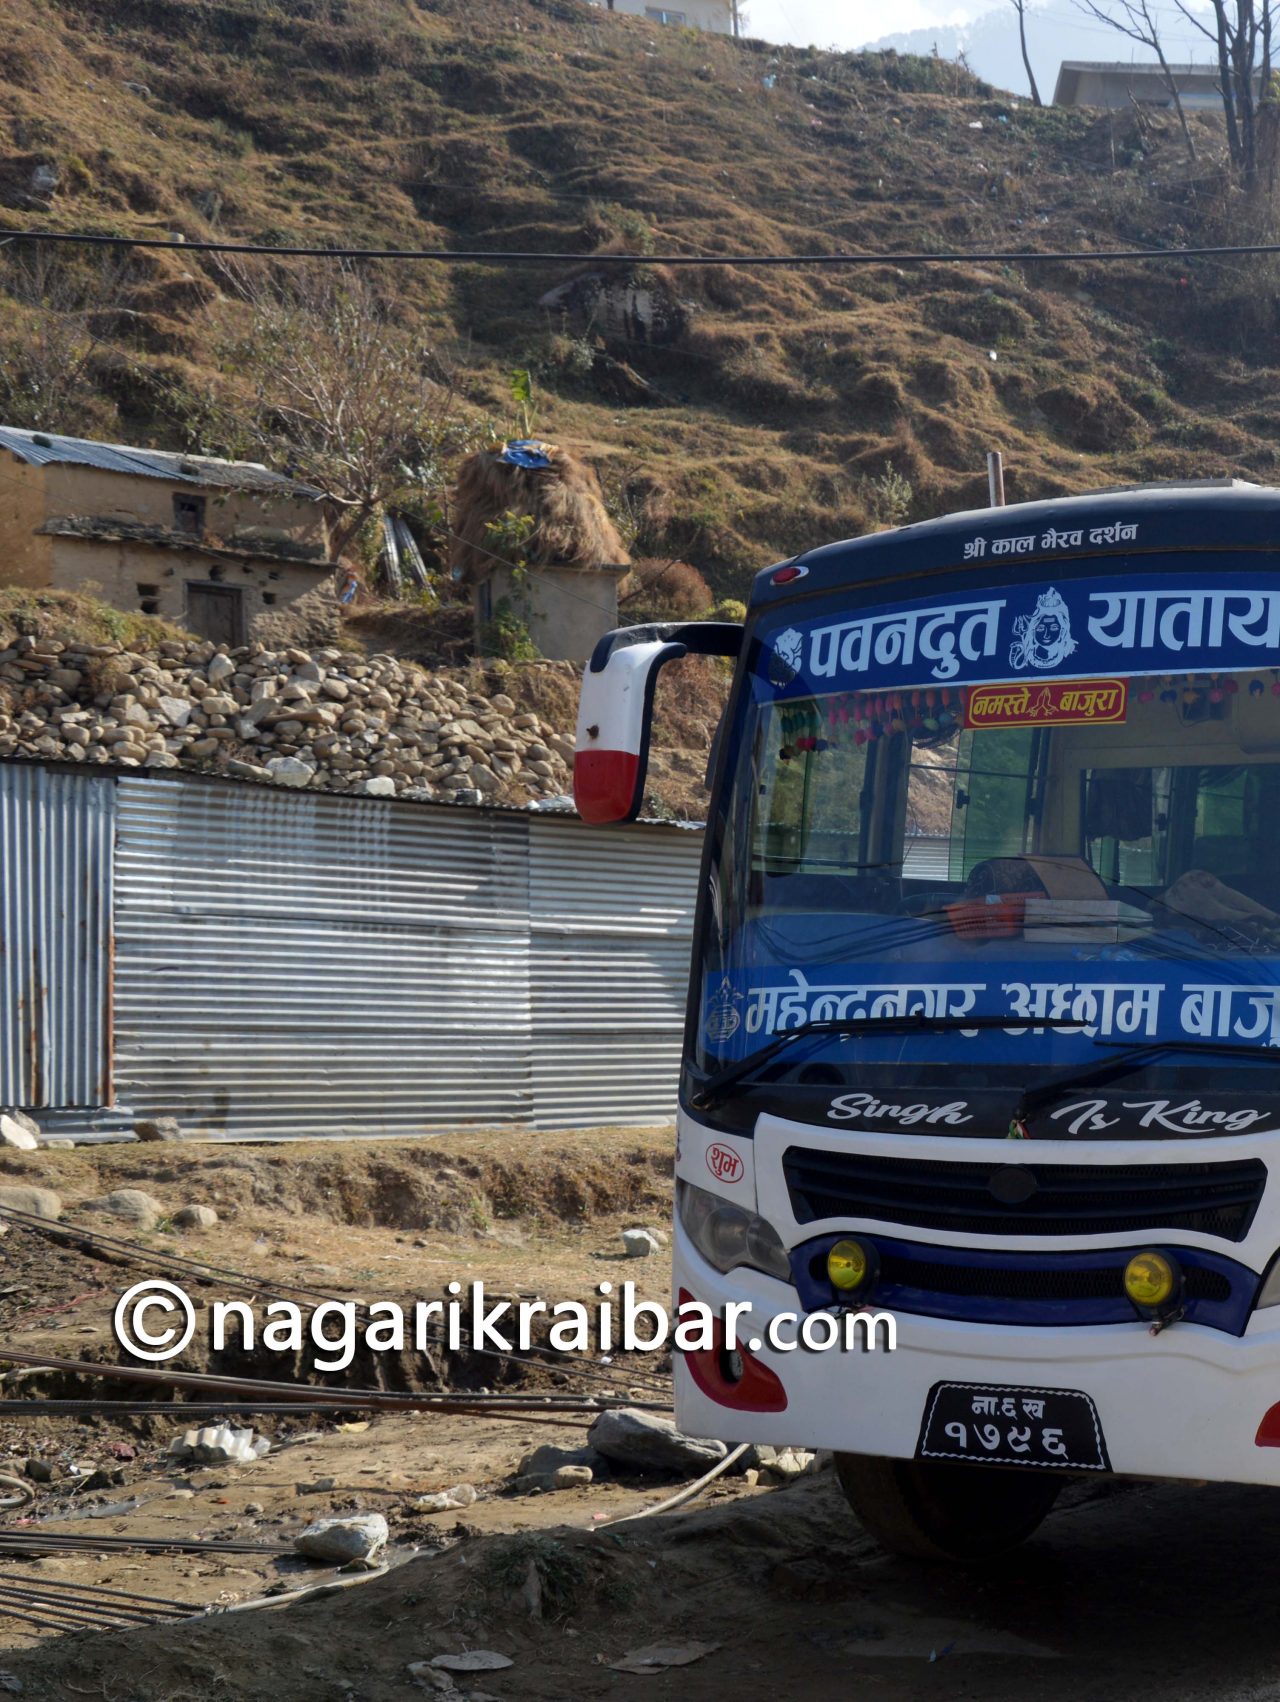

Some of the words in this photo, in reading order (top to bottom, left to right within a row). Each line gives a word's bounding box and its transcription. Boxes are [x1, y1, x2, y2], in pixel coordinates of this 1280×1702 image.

[963, 536, 987, 559] श्री
[991, 535, 1037, 555] काल
[1041, 527, 1084, 549] भैरव
[1089, 521, 1140, 545] दर्शन
[809, 599, 1007, 679] पवनदुत
[972, 687, 1032, 717] नमस्ते
[1058, 689, 1120, 717] बाजुरा
[826, 1092, 974, 1125] Singh
[1050, 1099, 1120, 1135] Is
[1122, 1099, 1271, 1133] King
[710, 1146, 740, 1177] शुभ
